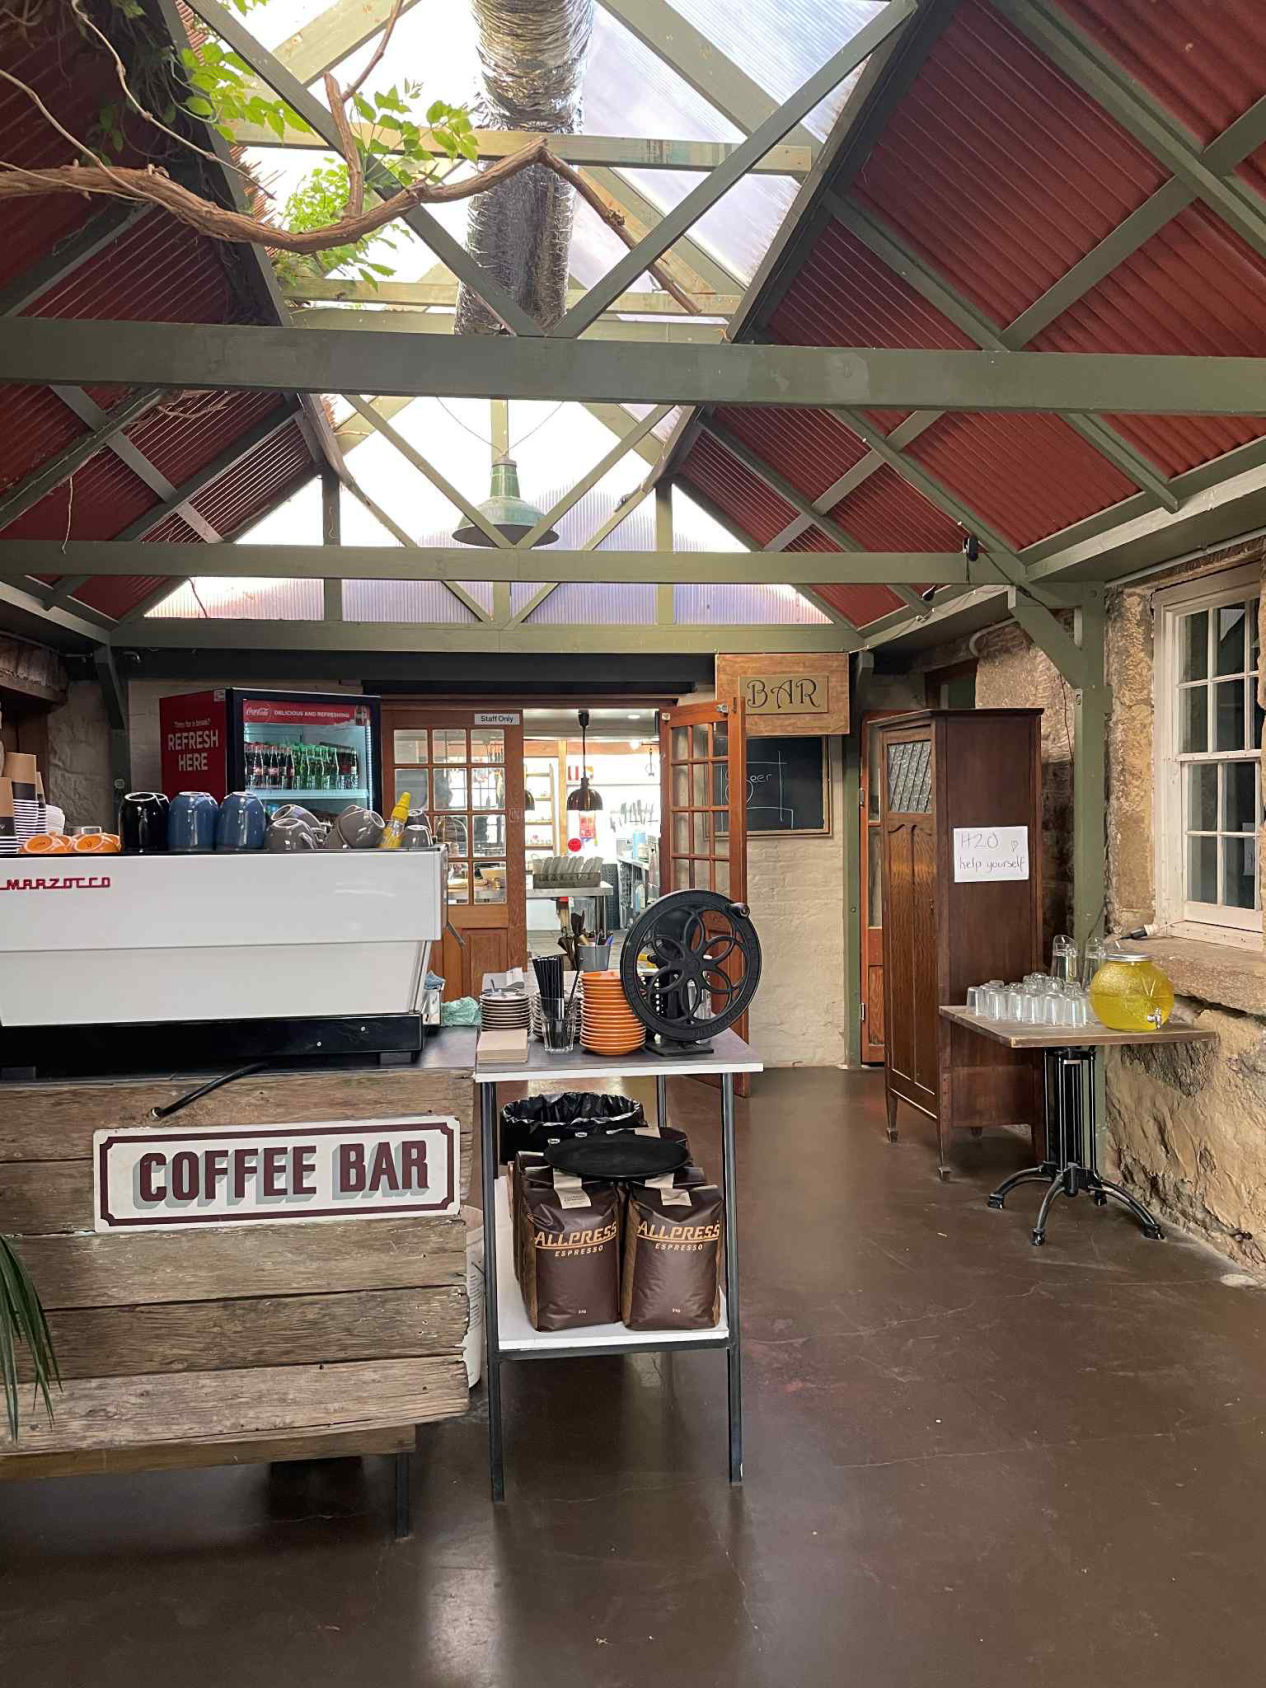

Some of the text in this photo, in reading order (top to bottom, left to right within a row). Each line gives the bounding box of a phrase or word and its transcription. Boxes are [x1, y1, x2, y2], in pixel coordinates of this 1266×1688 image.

[747, 679, 821, 709] BAR
[274, 709, 303, 717] DELICIOUS
[316, 710, 350, 718] REFRESHING
[498, 714, 514, 723] Only
[168, 730, 219, 751] REFRESH
[178, 752, 208, 771] HERE
[959, 856, 1025, 873] help yourself
[135, 1140, 430, 1207] COFFEE BAR
[534, 1221, 617, 1246] ALLPRESS
[637, 1220, 720, 1241] ALLPRESS
[554, 1244, 604, 1257] ESPRESSO
[654, 1243, 703, 1251] ESPRESSO
